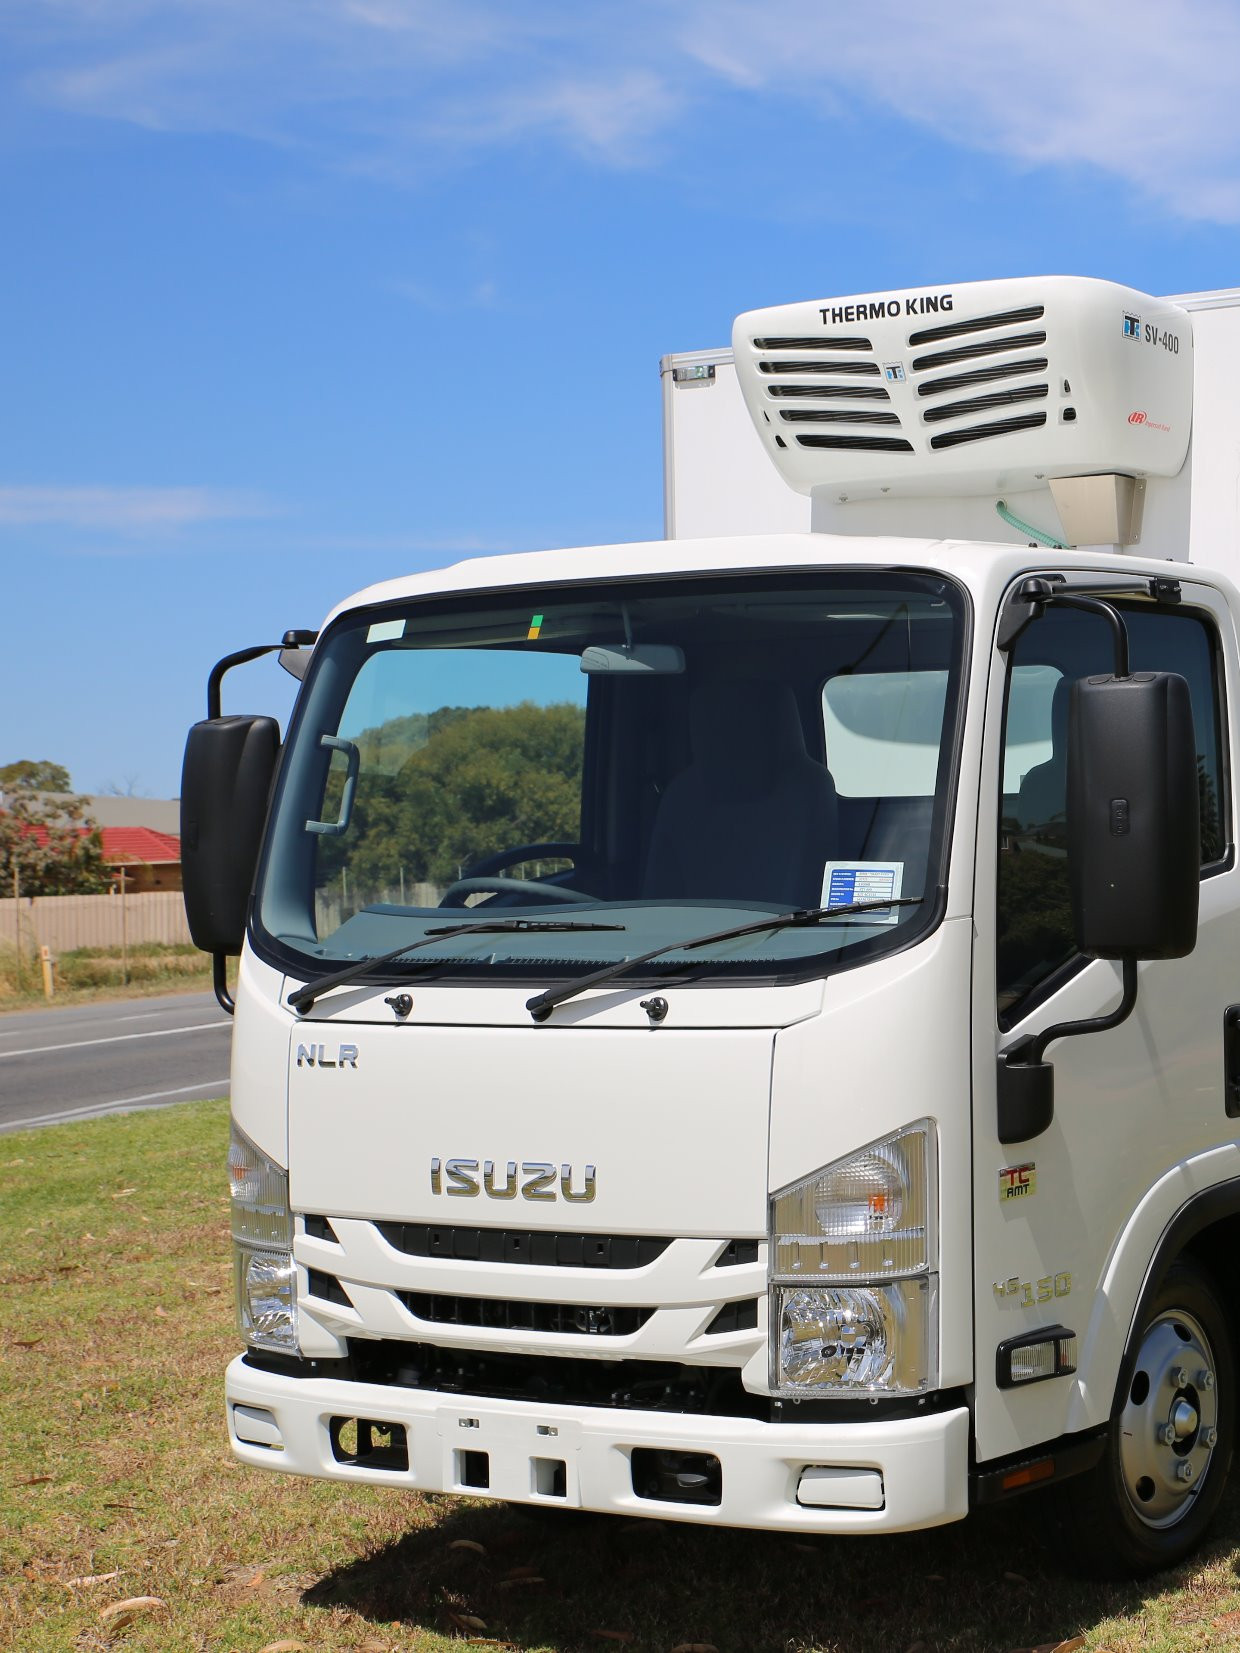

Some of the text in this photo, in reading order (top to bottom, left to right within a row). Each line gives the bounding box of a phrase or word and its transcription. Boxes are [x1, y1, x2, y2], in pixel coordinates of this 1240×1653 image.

[819, 294, 953, 324] THERMO KING
[1145, 324, 1179, 354] SV-400
[297, 1043, 359, 1069] NLR
[430, 1157, 597, 1203] ISUZU
[1006, 1183, 1030, 1198] AMT
